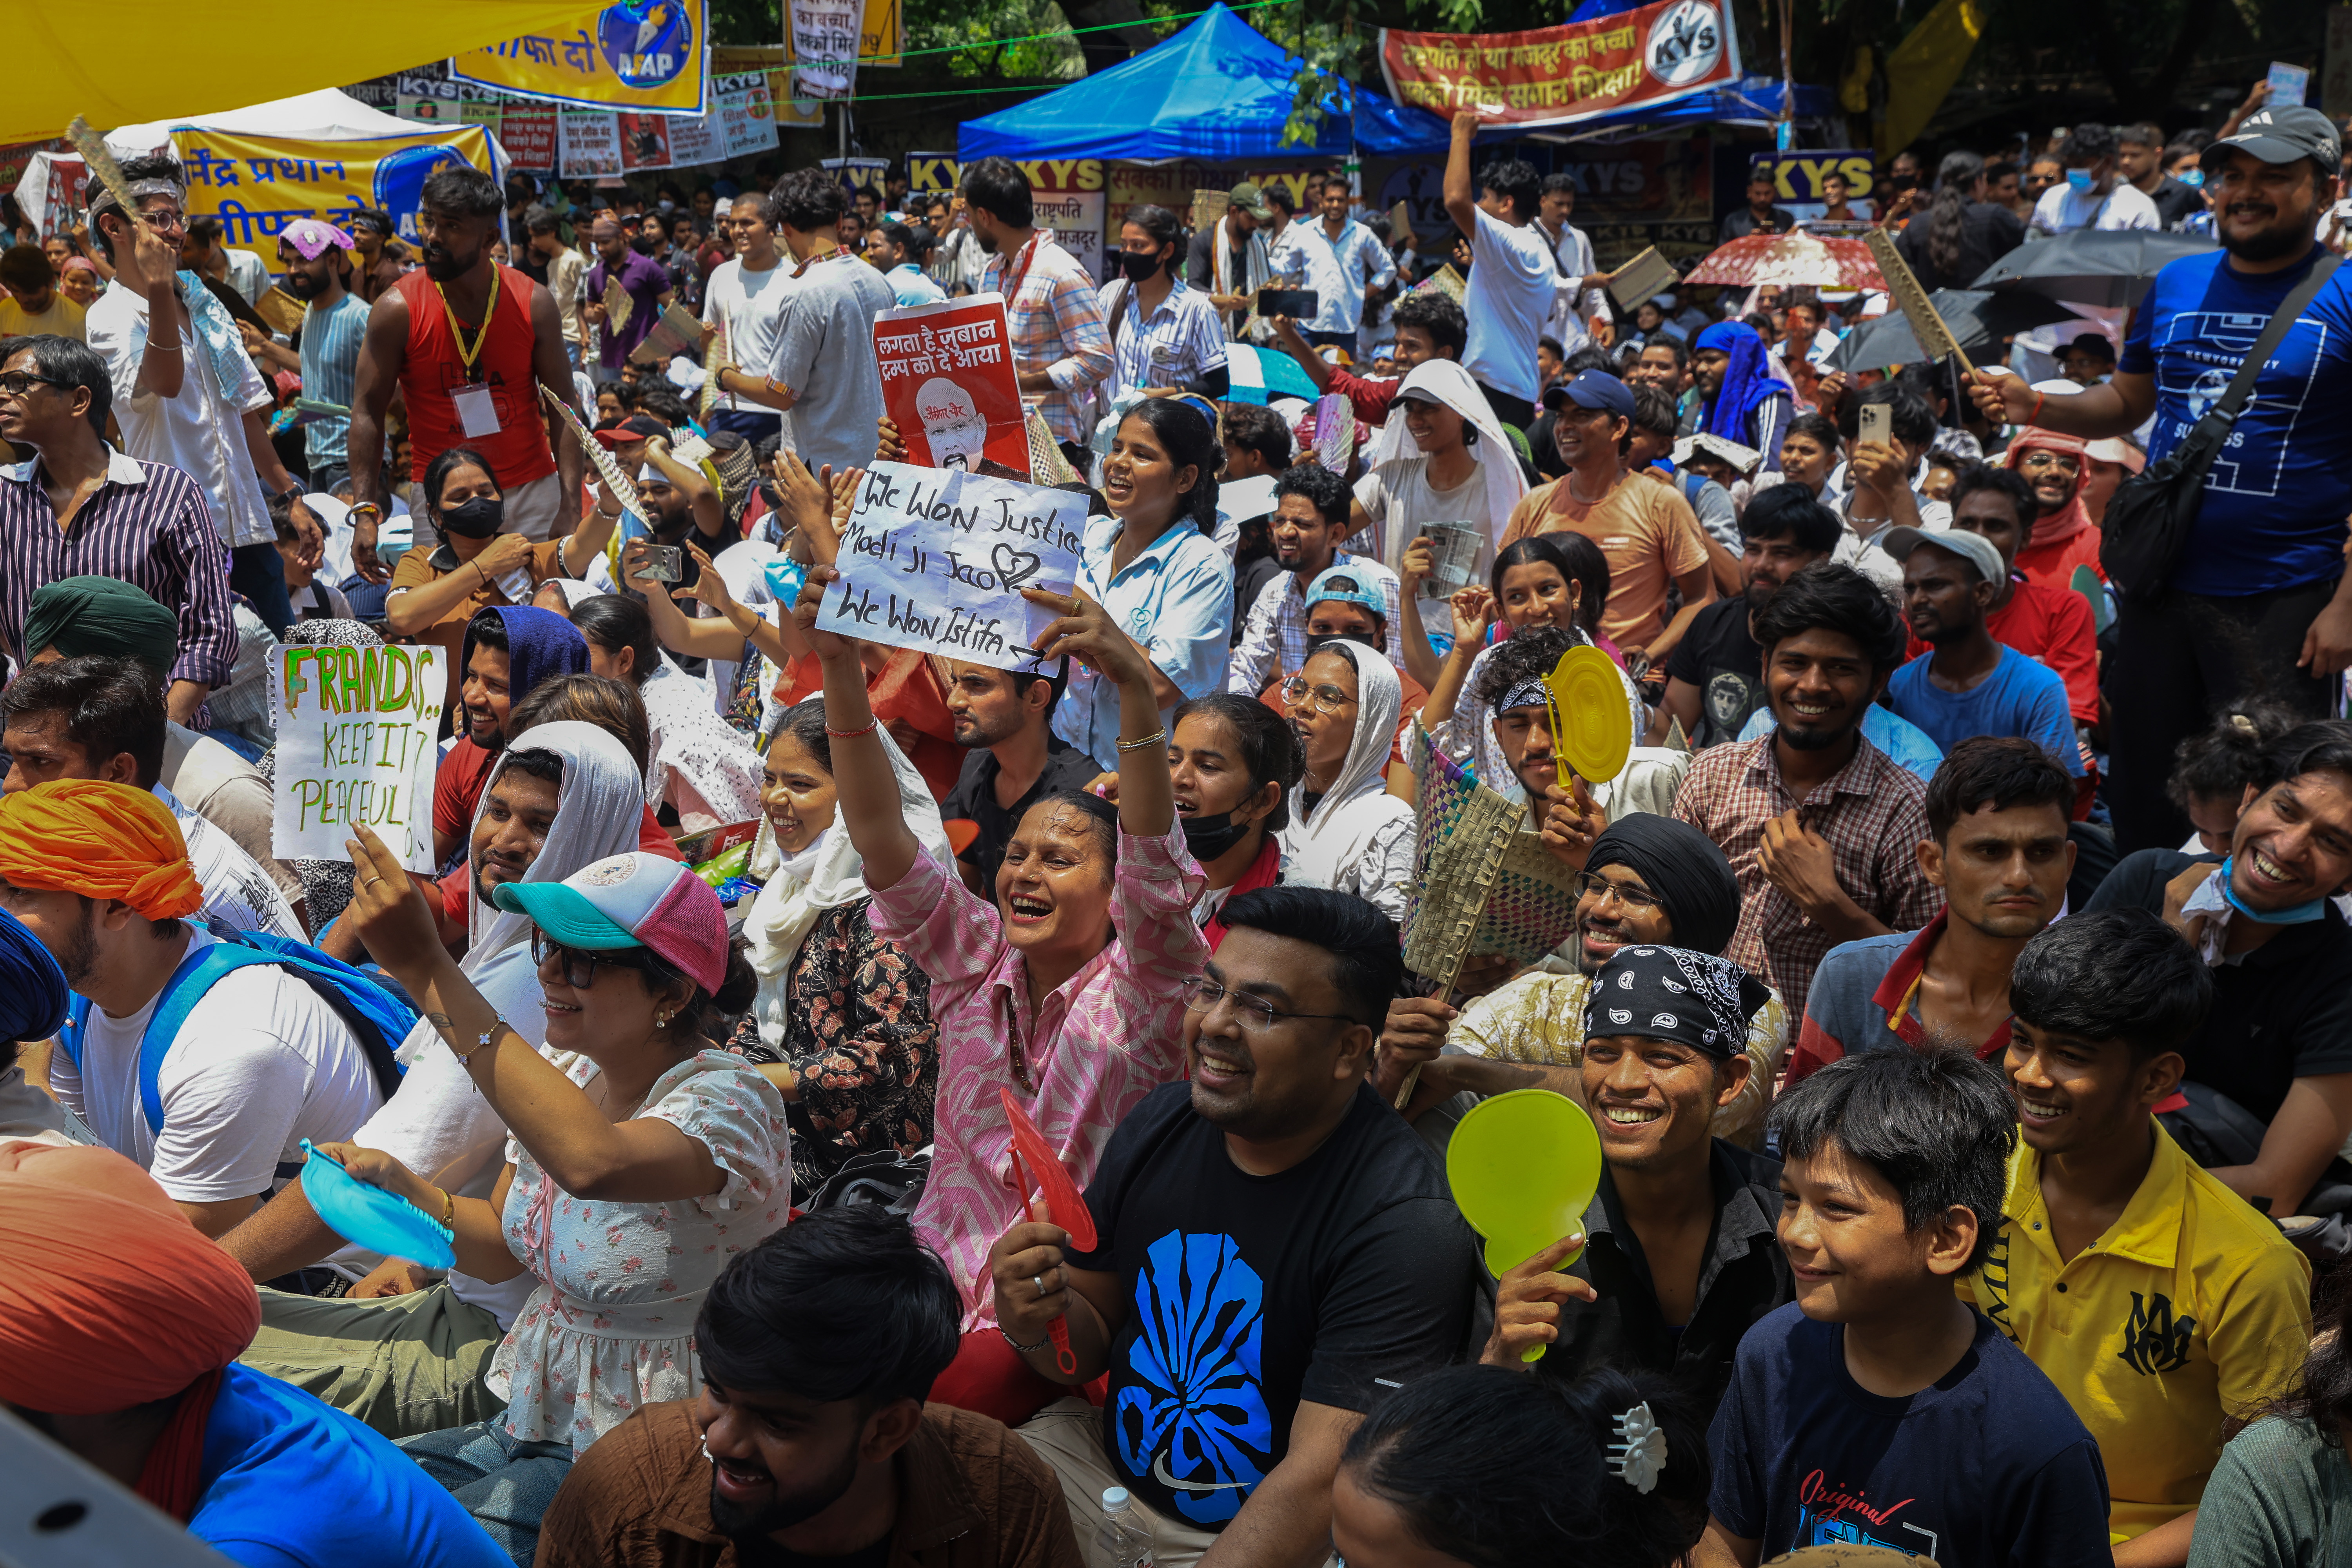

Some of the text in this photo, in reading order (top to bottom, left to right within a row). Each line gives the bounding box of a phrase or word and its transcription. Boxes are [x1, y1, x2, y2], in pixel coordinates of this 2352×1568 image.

[562, 30, 595, 73] दो
[1464, 38, 1481, 74] हो
[1483, 47, 1508, 71] या
[1511, 42, 1561, 75] मजदूर
[1563, 36, 1589, 62] का
[1592, 24, 1637, 54] बच्चा
[1655, 25, 1715, 65] KYS
[617, 52, 674, 77] ASAP
[403, 76, 457, 98] KYS
[717, 72, 762, 93] KYS
[1455, 75, 1505, 114] मिले
[1507, 79, 1572, 110] समान
[1572, 58, 1642, 103] शिक्षा!
[247, 158, 347, 184] प्रधान
[1015, 159, 1104, 191] KYS
[1111, 161, 1173, 191] सबको
[1565, 160, 1645, 194] KYS
[1757, 157, 1874, 200] KYS
[1033, 198, 1083, 224] राष्ट्रपति
[1056, 230, 1098, 252] मजदूर
[1661, 225, 1713, 241] KYS
[877, 319, 996, 354] लगता है ज़ुबान
[880, 359, 910, 381] ट्रम्प
[909, 350, 936, 375] को
[954, 343, 1002, 368] आया
[836, 583, 880, 625] We
[323, 721, 412, 773] KEEP IT
[595, 858, 633, 880] CALIFORNIA
[1800, 1468, 1916, 1526] Original
